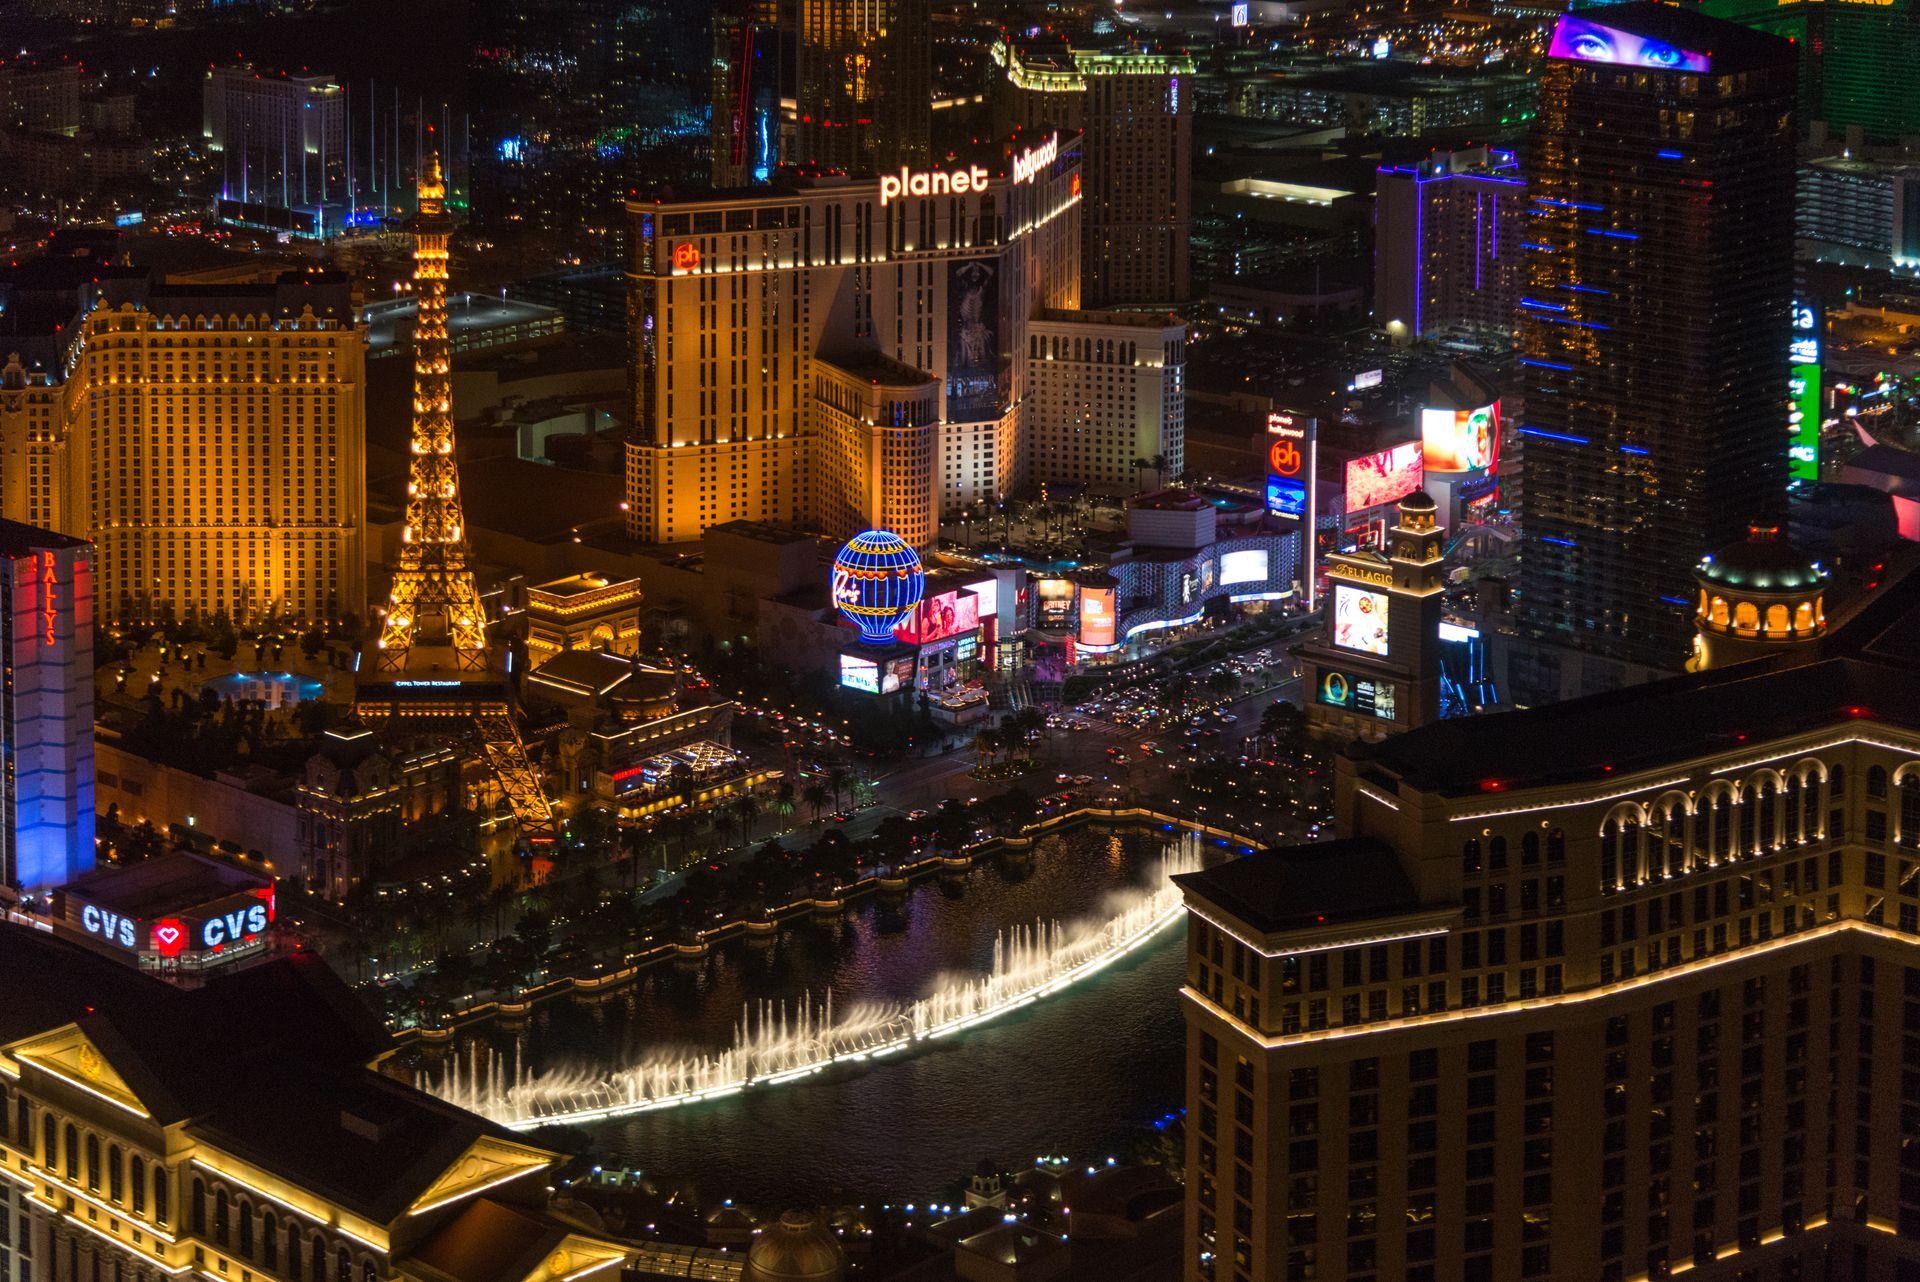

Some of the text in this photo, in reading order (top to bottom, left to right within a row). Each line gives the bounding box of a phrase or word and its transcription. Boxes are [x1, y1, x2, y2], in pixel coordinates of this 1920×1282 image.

[1237, 6, 1245, 26] 6
[880, 130, 1058, 206] planet hollywood
[675, 243, 700, 269] ph
[1268, 413, 1292, 425] planet
[1268, 424, 1304, 438] hollywood
[1272, 440, 1301, 473] ph
[833, 570, 861, 609] Paris
[1335, 563, 1393, 585] BELLAGIO
[43, 551, 57, 646] BALLYS
[82, 904, 136, 948] CVS
[203, 904, 267, 947] CVS
